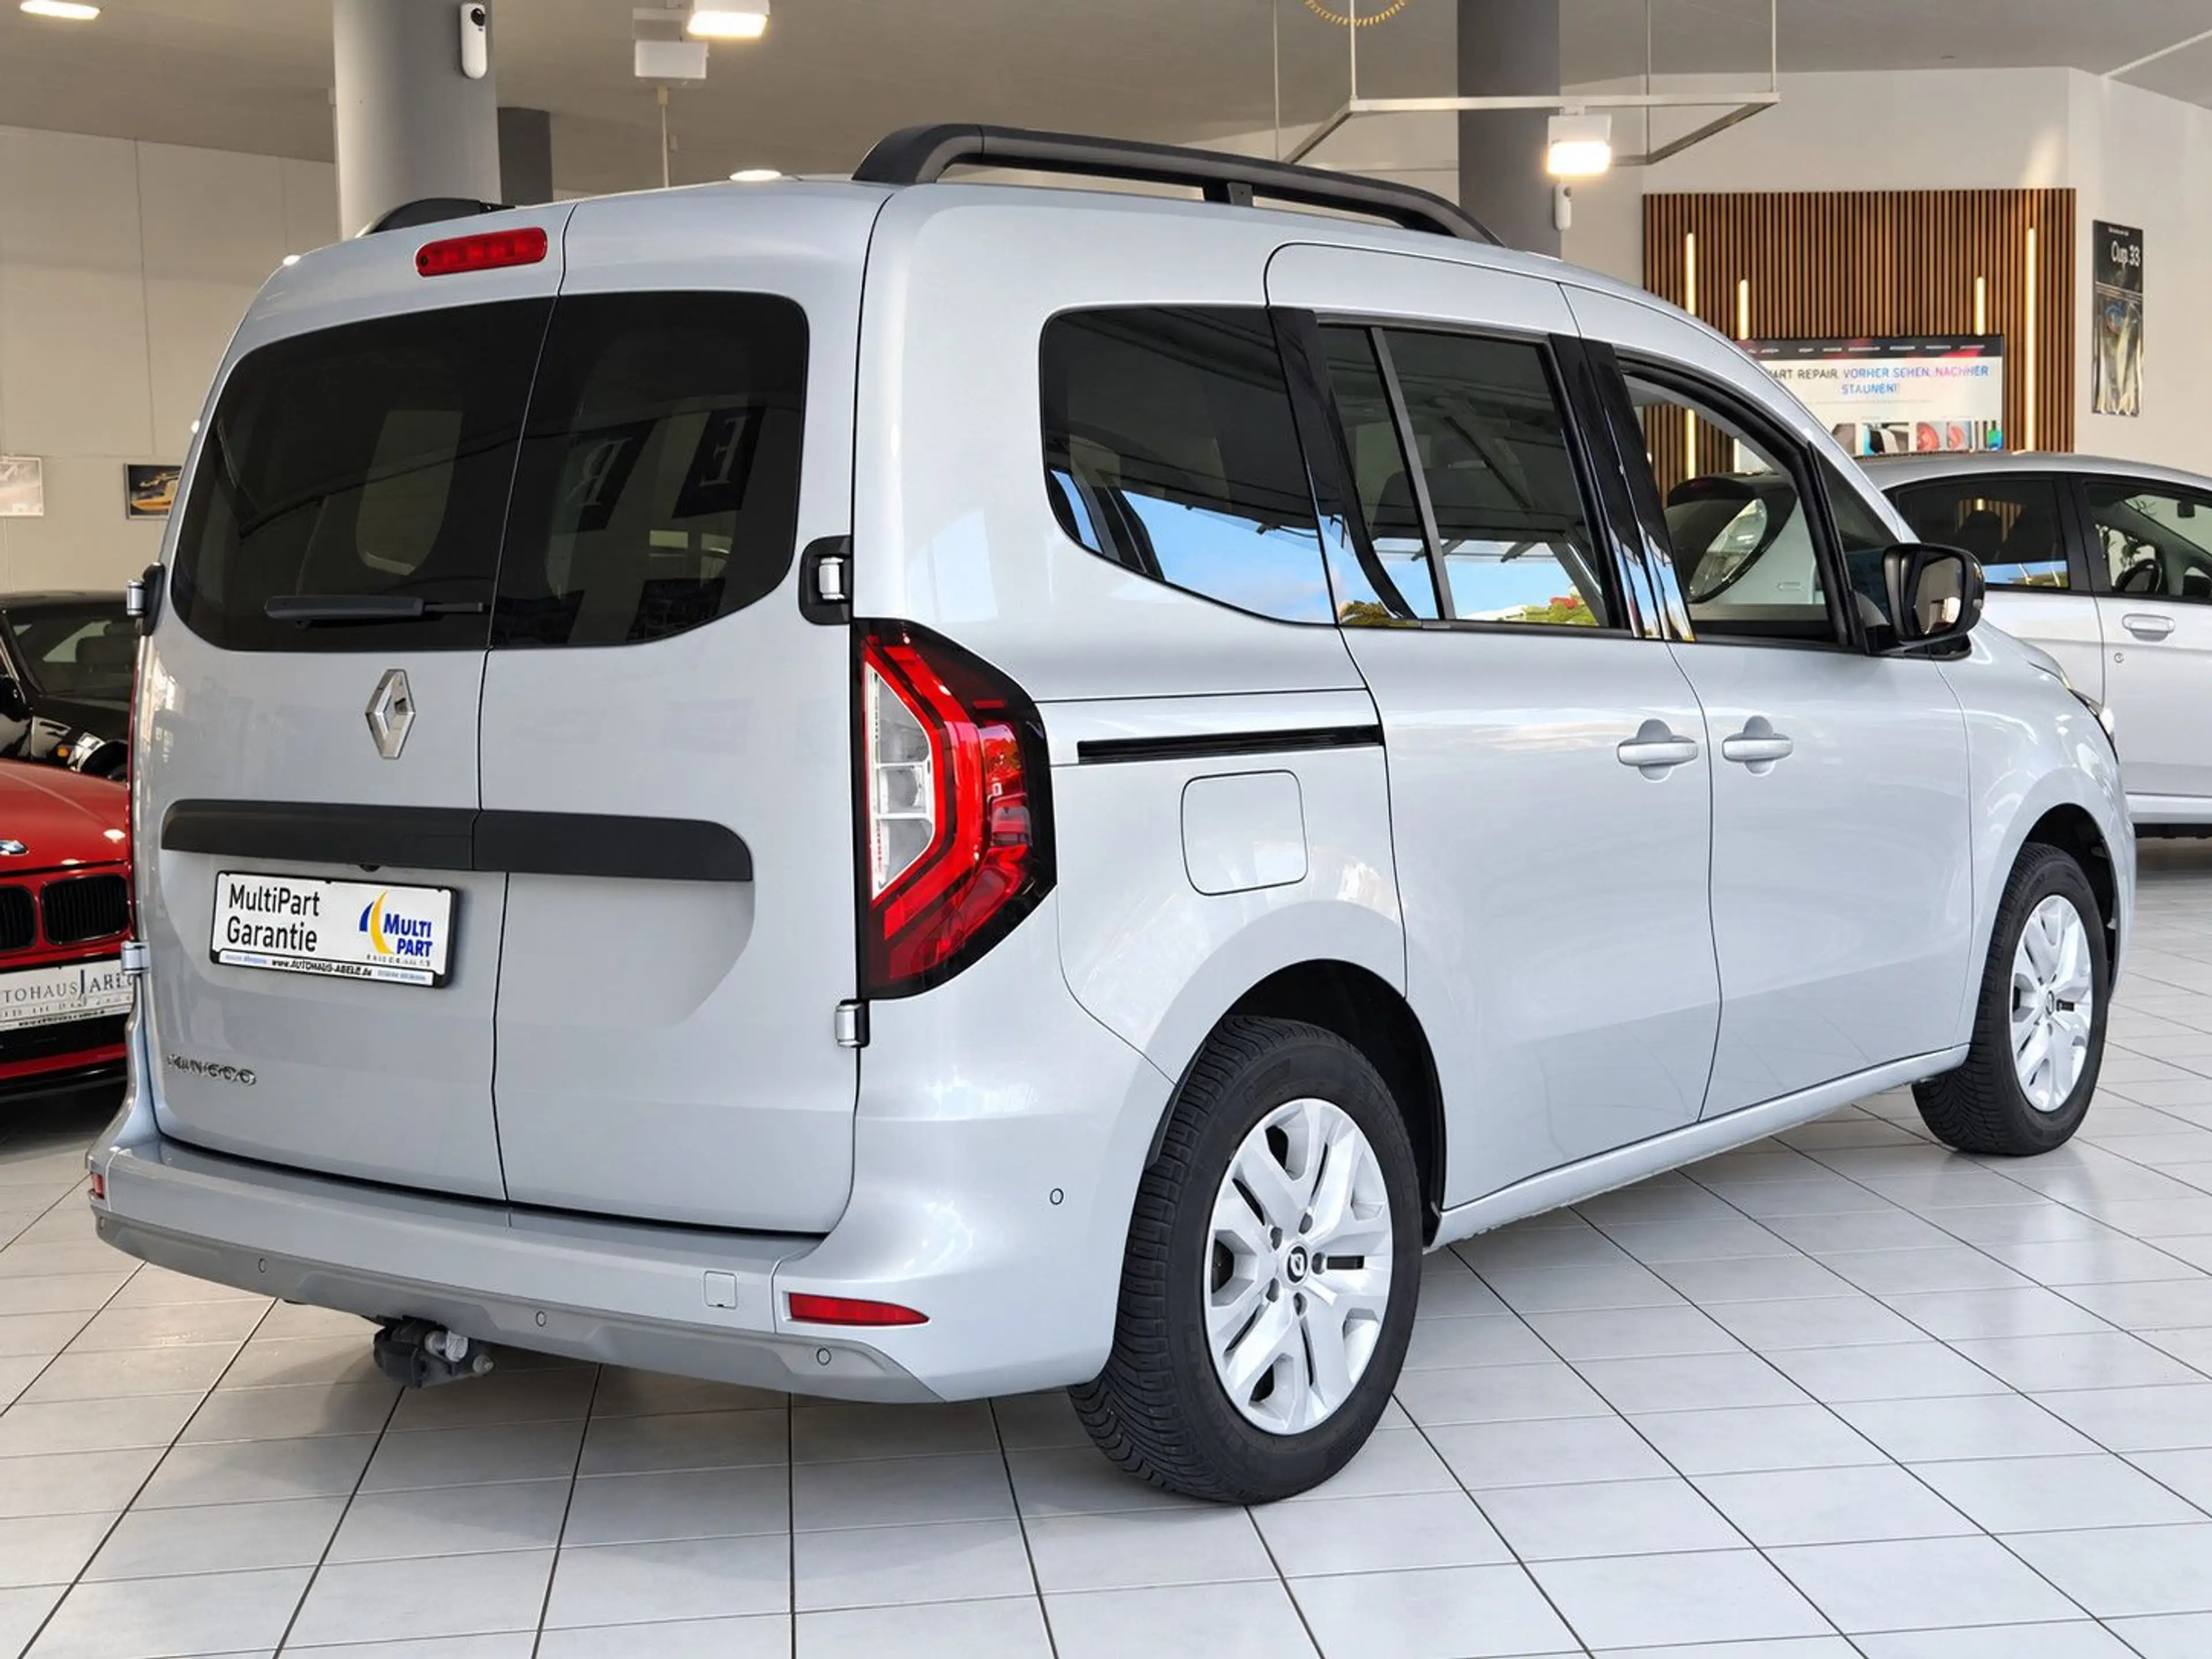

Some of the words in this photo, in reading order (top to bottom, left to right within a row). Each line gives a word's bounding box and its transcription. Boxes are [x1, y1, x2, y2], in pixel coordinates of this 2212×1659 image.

[1843, 367, 1889, 379] VORHER
[1935, 365, 1989, 378] NACHHER
[229, 884, 320, 917] MultiPart
[227, 915, 317, 952] Garantie
[397, 939, 433, 958] PART
